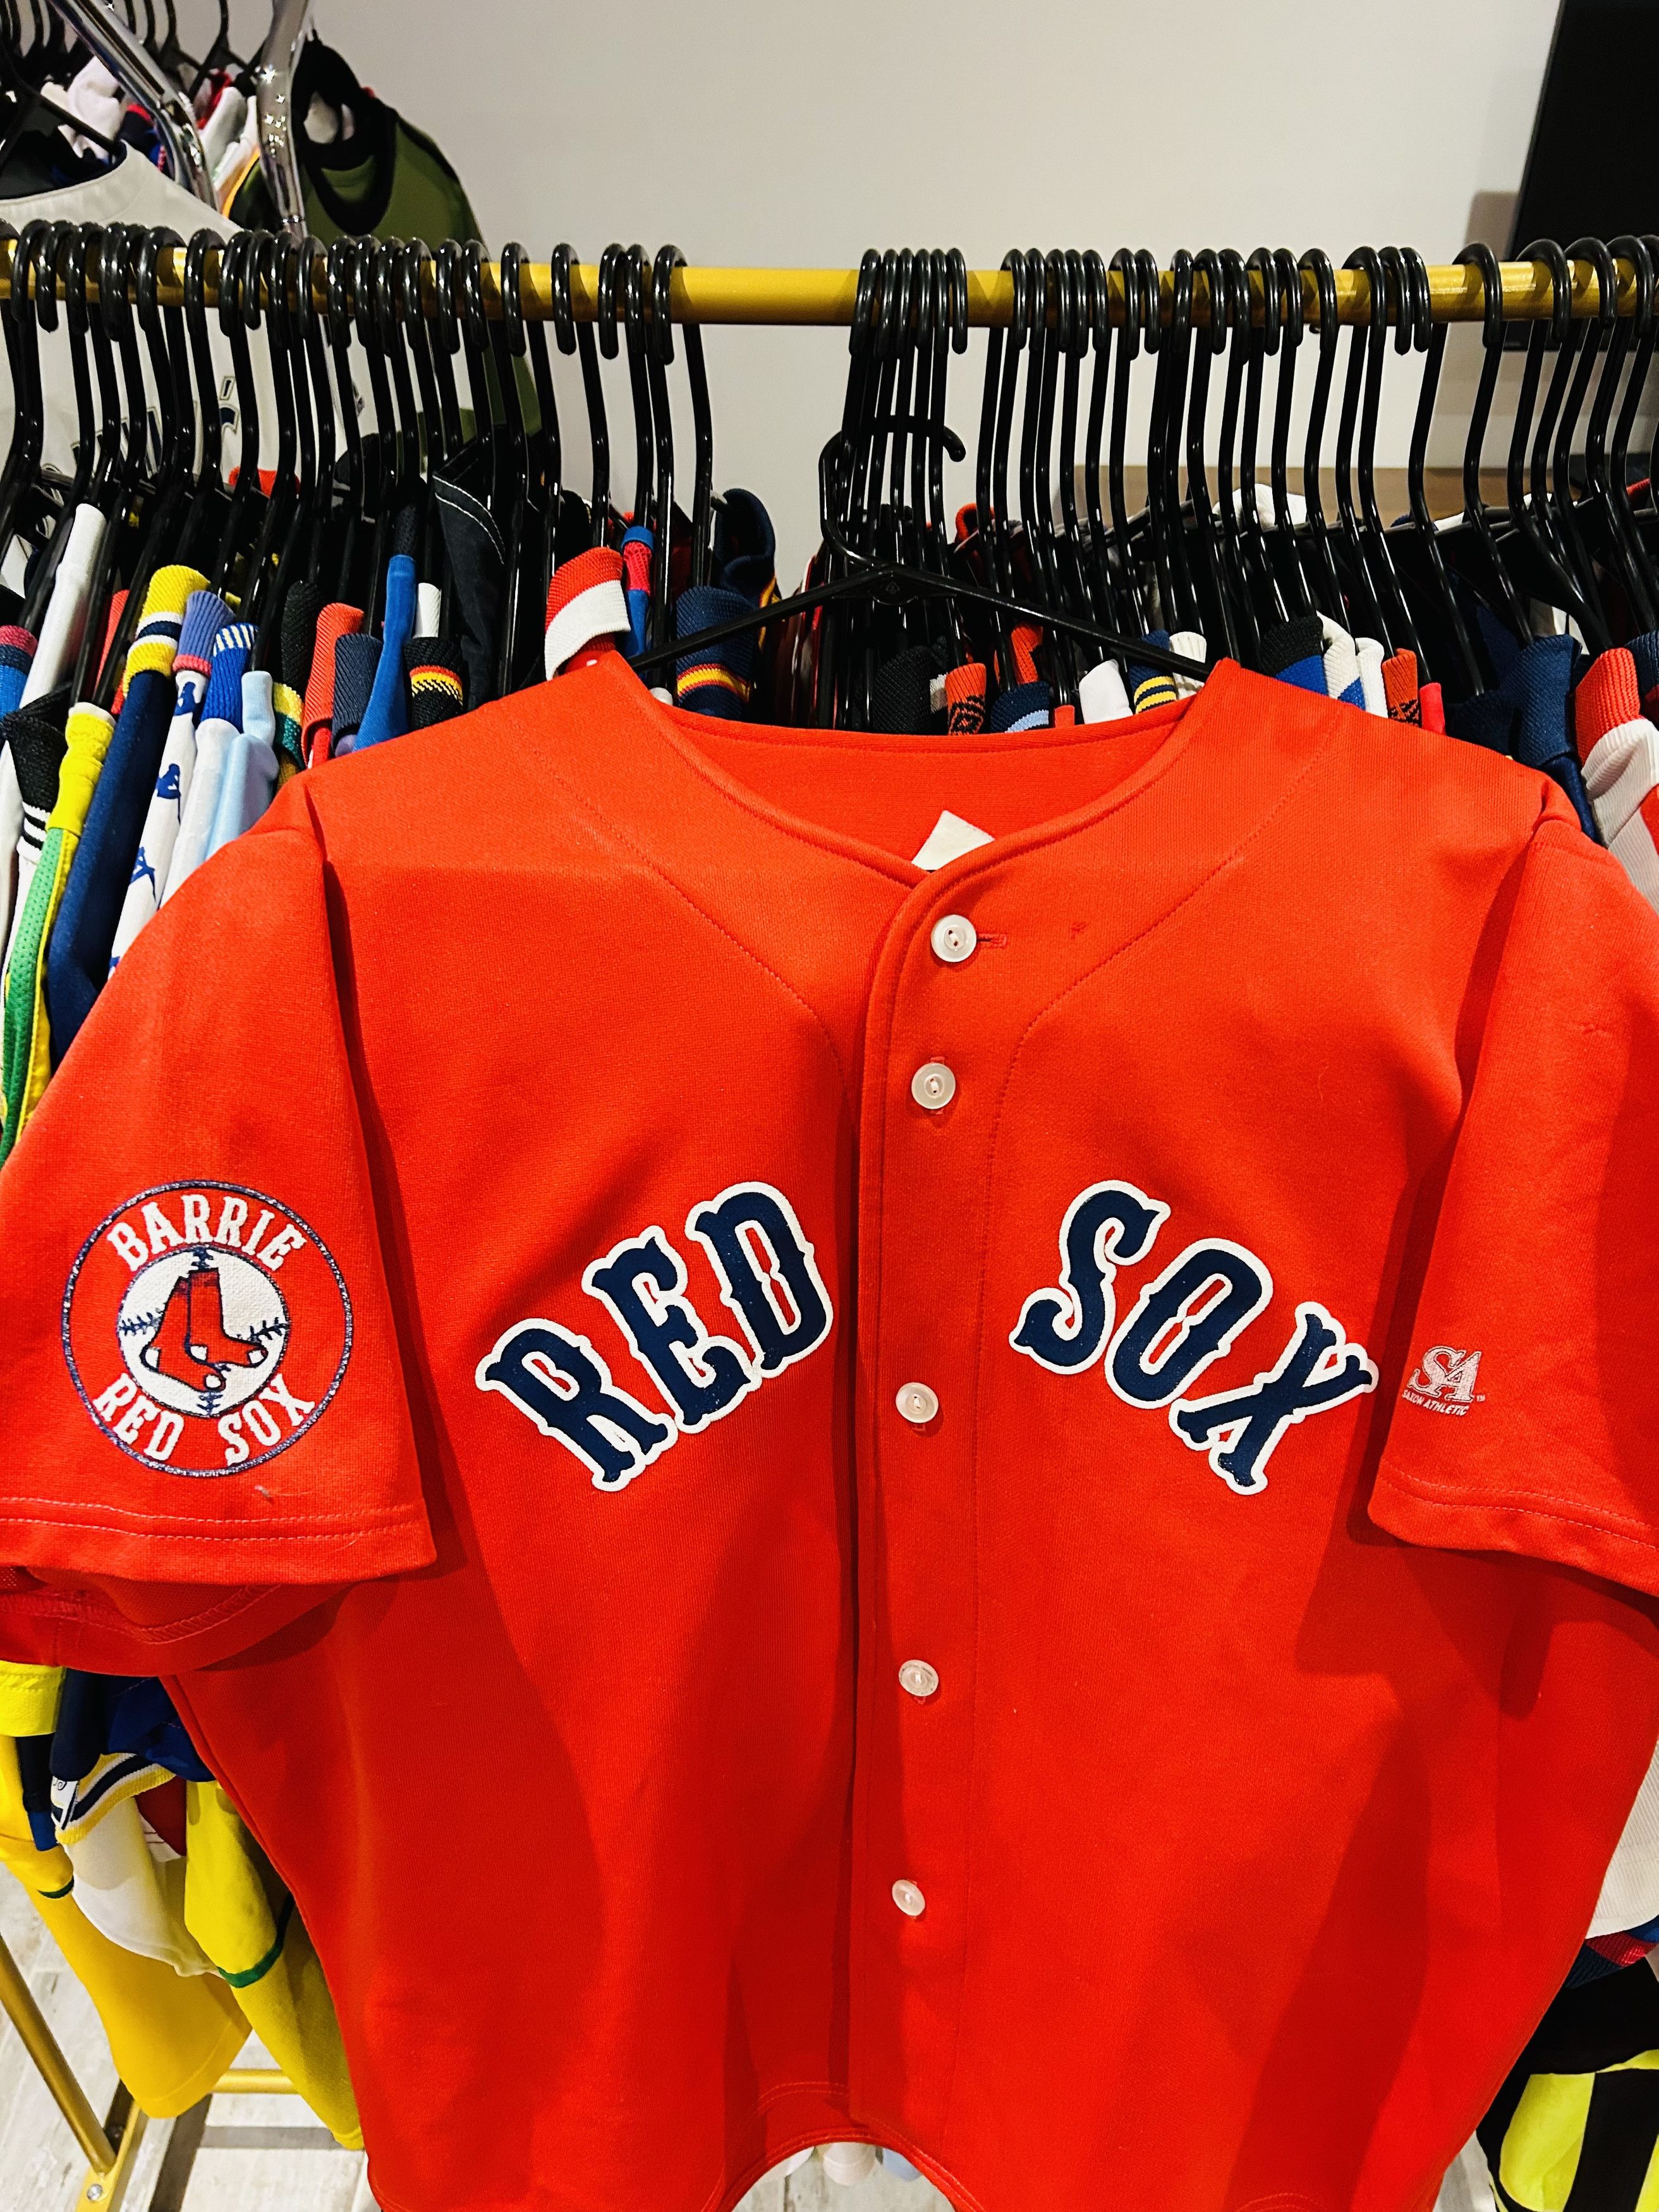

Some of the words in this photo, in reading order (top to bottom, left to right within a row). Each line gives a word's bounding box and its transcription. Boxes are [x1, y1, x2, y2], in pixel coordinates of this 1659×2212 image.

[107, 1194, 307, 1272] BARRIE
[475, 1181, 834, 1492] RED
[1009, 1179, 1379, 1495] SOX
[93, 1373, 185, 1461] RED
[217, 1373, 315, 1466] SOX
[1423, 1399, 1470, 1416] ATHLETIC
